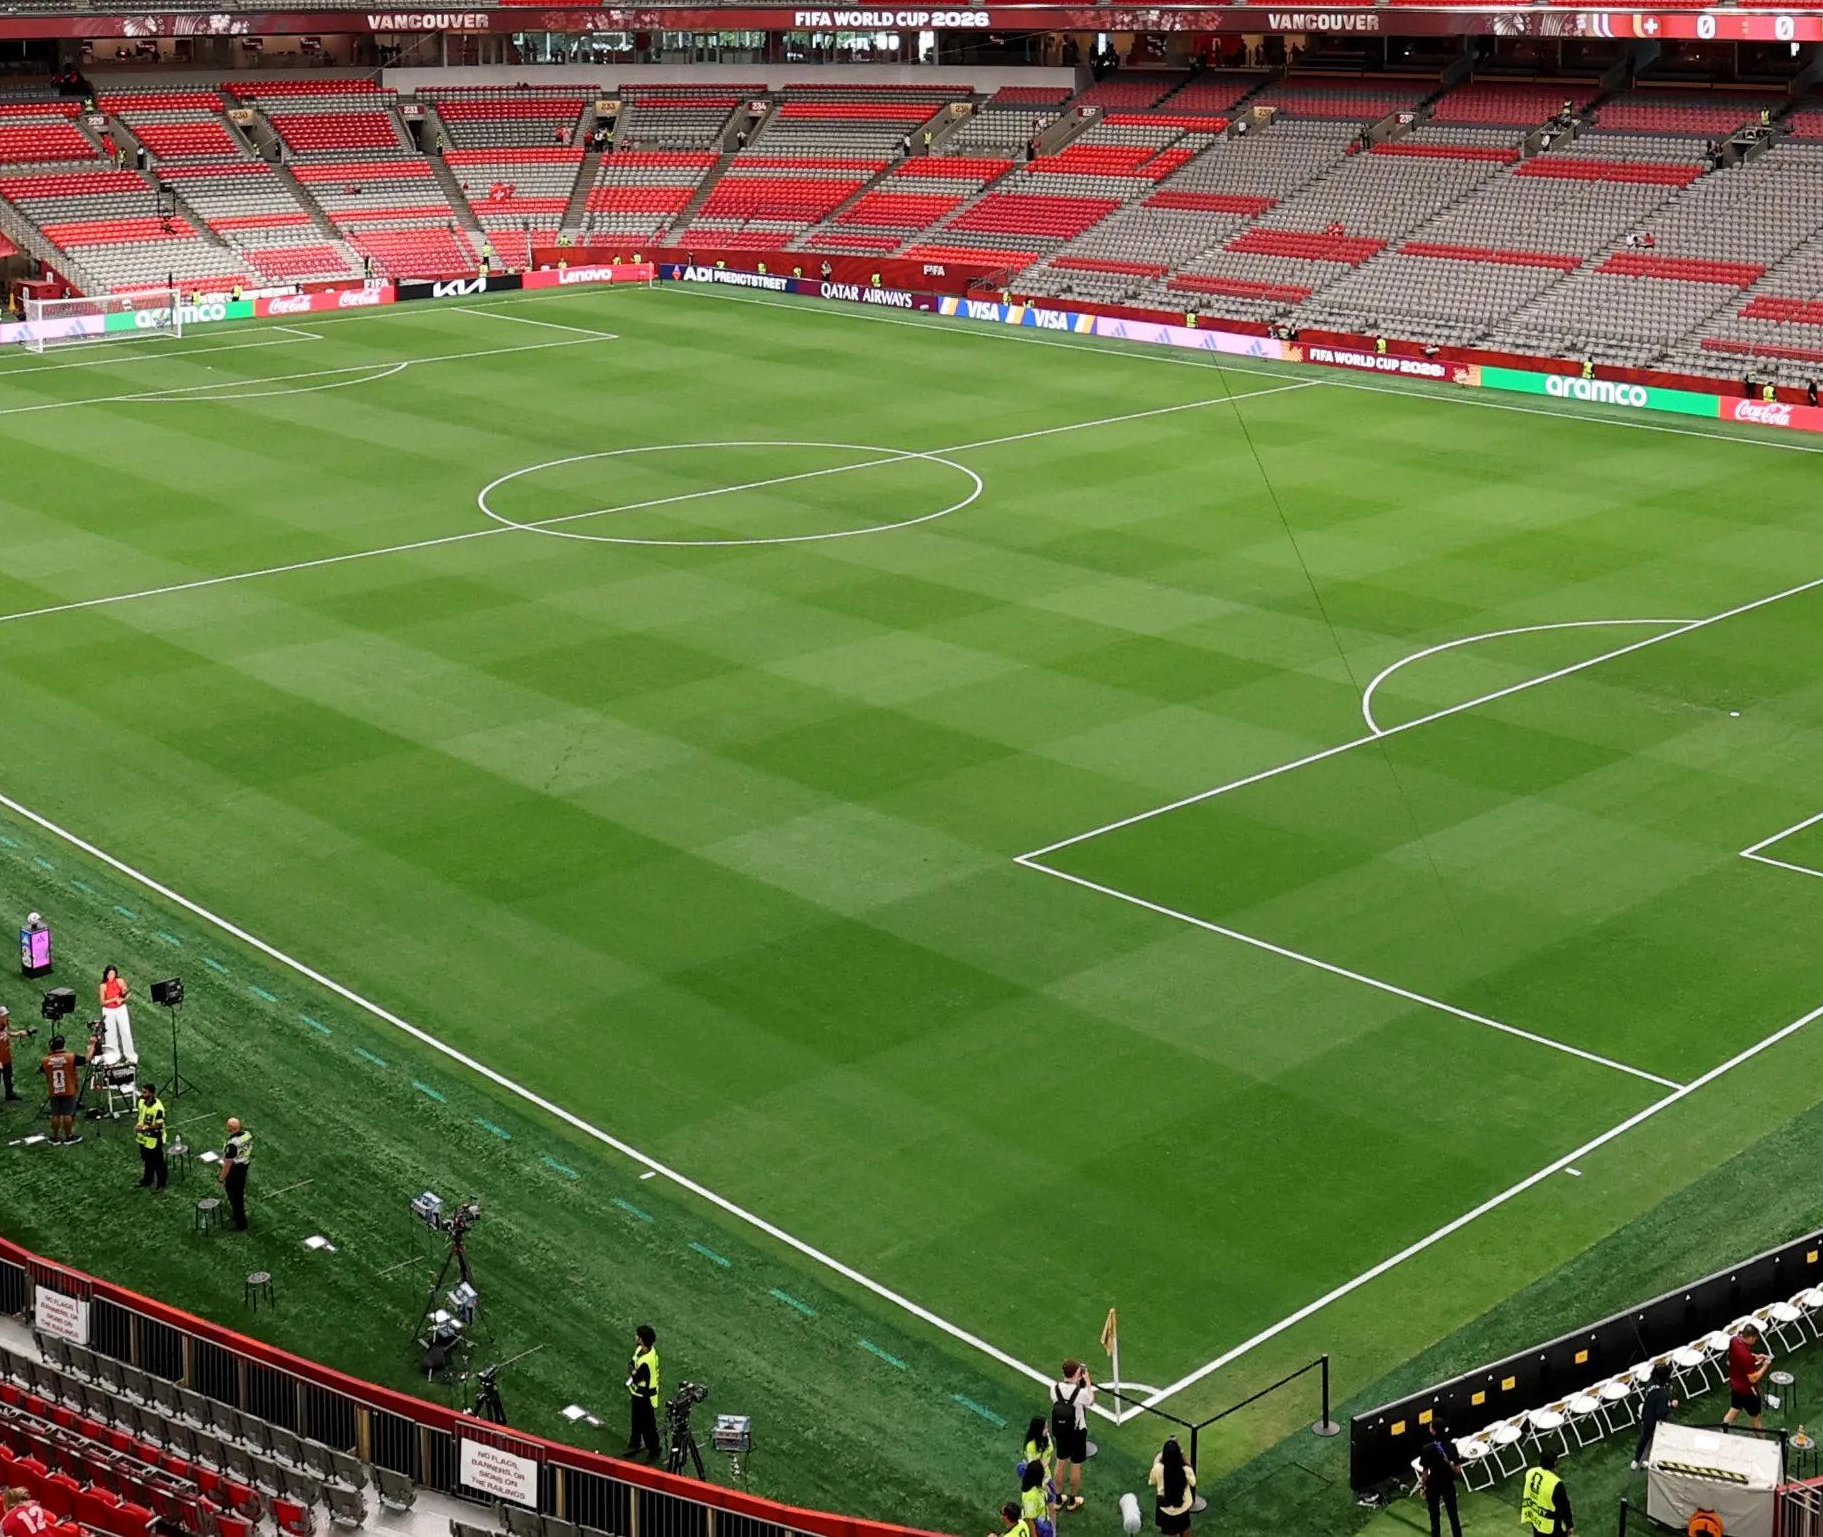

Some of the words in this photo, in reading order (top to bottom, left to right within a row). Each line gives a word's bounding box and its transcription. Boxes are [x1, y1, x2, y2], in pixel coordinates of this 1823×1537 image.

[367, 14, 488, 30] VANCOUVER
[795, 12, 832, 26] FIFA
[834, 12, 894, 26] WORLD
[896, 12, 928, 26] CUP
[931, 12, 989, 26] 2026
[1268, 14, 1379, 30] VANCOUVER
[1696, 14, 1716, 40] 0
[1774, 16, 1794, 41] 0
[404, 106, 418, 114] 231
[752, 102, 767, 111] 234
[559, 268, 612, 284] Lenovo
[683, 268, 713, 282] ADI
[714, 270, 788, 290] PREDICTSTREET
[923, 264, 945, 276] FIFA
[820, 282, 858, 300] QATAR
[862, 287, 913, 308] AIRWAYS
[966, 300, 1000, 322] VISA
[1033, 308, 1068, 331] VISA
[1310, 348, 1332, 362] FIFA
[1334, 352, 1375, 369] WORLD
[1376, 357, 1399, 371] CUP
[1400, 360, 1443, 376] 2026
[1546, 374, 1648, 407] aramco
[478, 1450, 490, 1460] NO
[478, 1470, 503, 1484] SIGNS
[504, 1478, 518, 1488] ON
[514, 1472, 525, 1482] OR
[471, 1476, 486, 1487] THE
[487, 1482, 525, 1500] RAILINGS
[16, 1505, 46, 1534] 12
